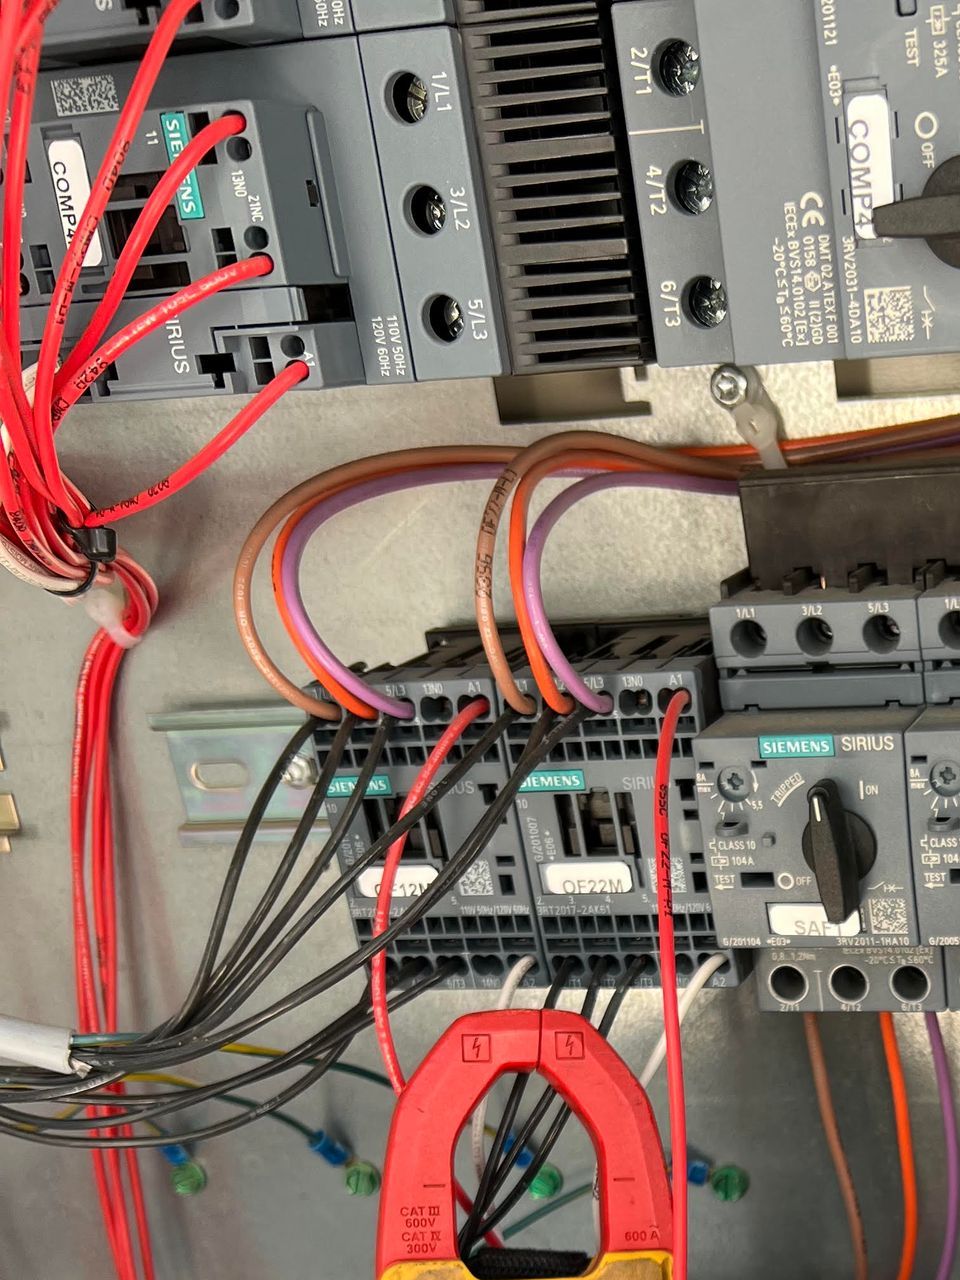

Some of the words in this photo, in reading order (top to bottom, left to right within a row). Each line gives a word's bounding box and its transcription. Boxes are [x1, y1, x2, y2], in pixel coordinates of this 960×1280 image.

[905, 28, 919, 67] TEST
[934, 40, 948, 78] 325A
[631, 47, 652, 95] 2/T1
[431, 71, 453, 112] 1/L1
[921, 142, 935, 168] OFF
[646, 165, 667, 215] 4/T2
[248, 195, 264, 222] 21NC
[449, 186, 470, 231] 3/L2
[803, 236, 816, 267] 0158
[818, 235, 832, 261] DMT
[822, 281, 836, 313] ATEX
[842, 236, 863, 344] 3RV2031-4DA10
[660, 281, 681, 328] 6/T3
[467, 299, 488, 340] 5/L3
[371, 316, 386, 345] 120V
[386, 315, 400, 343] 110V
[827, 324, 838, 344] 001
[376, 346, 391, 377] 60Hz
[391, 345, 406, 376] 50Hz
[736, 608, 756, 619] 1/L1
[802, 605, 823, 616] 3/L2
[868, 603, 890, 614] 5/L3
[467, 681, 481, 693] A1
[669, 674, 683, 686] A1
[763, 740, 830, 754] SIEMENS
[841, 736, 895, 752] SIRIUS
[771, 772, 803, 803] TRIPPED
[865, 784, 879, 796] ON
[718, 841, 744, 850] CLASS
[745, 840, 756, 850] 10
[930, 838, 957, 848] CLASS
[732, 856, 755, 866] 104A
[562, 878, 625, 895] OF22M
[714, 875, 736, 885] TEST
[795, 876, 812, 886] OFF
[924, 873, 946, 883] TEST
[836, 936, 910, 946] 3RV2011-1HA10
[400, 1206, 427, 1217] CAT
[405, 1217, 436, 1228] 600V
[401, 1231, 428, 1242] CAT
[624, 1231, 647, 1242] 600
[406, 1243, 437, 1254] 300V
